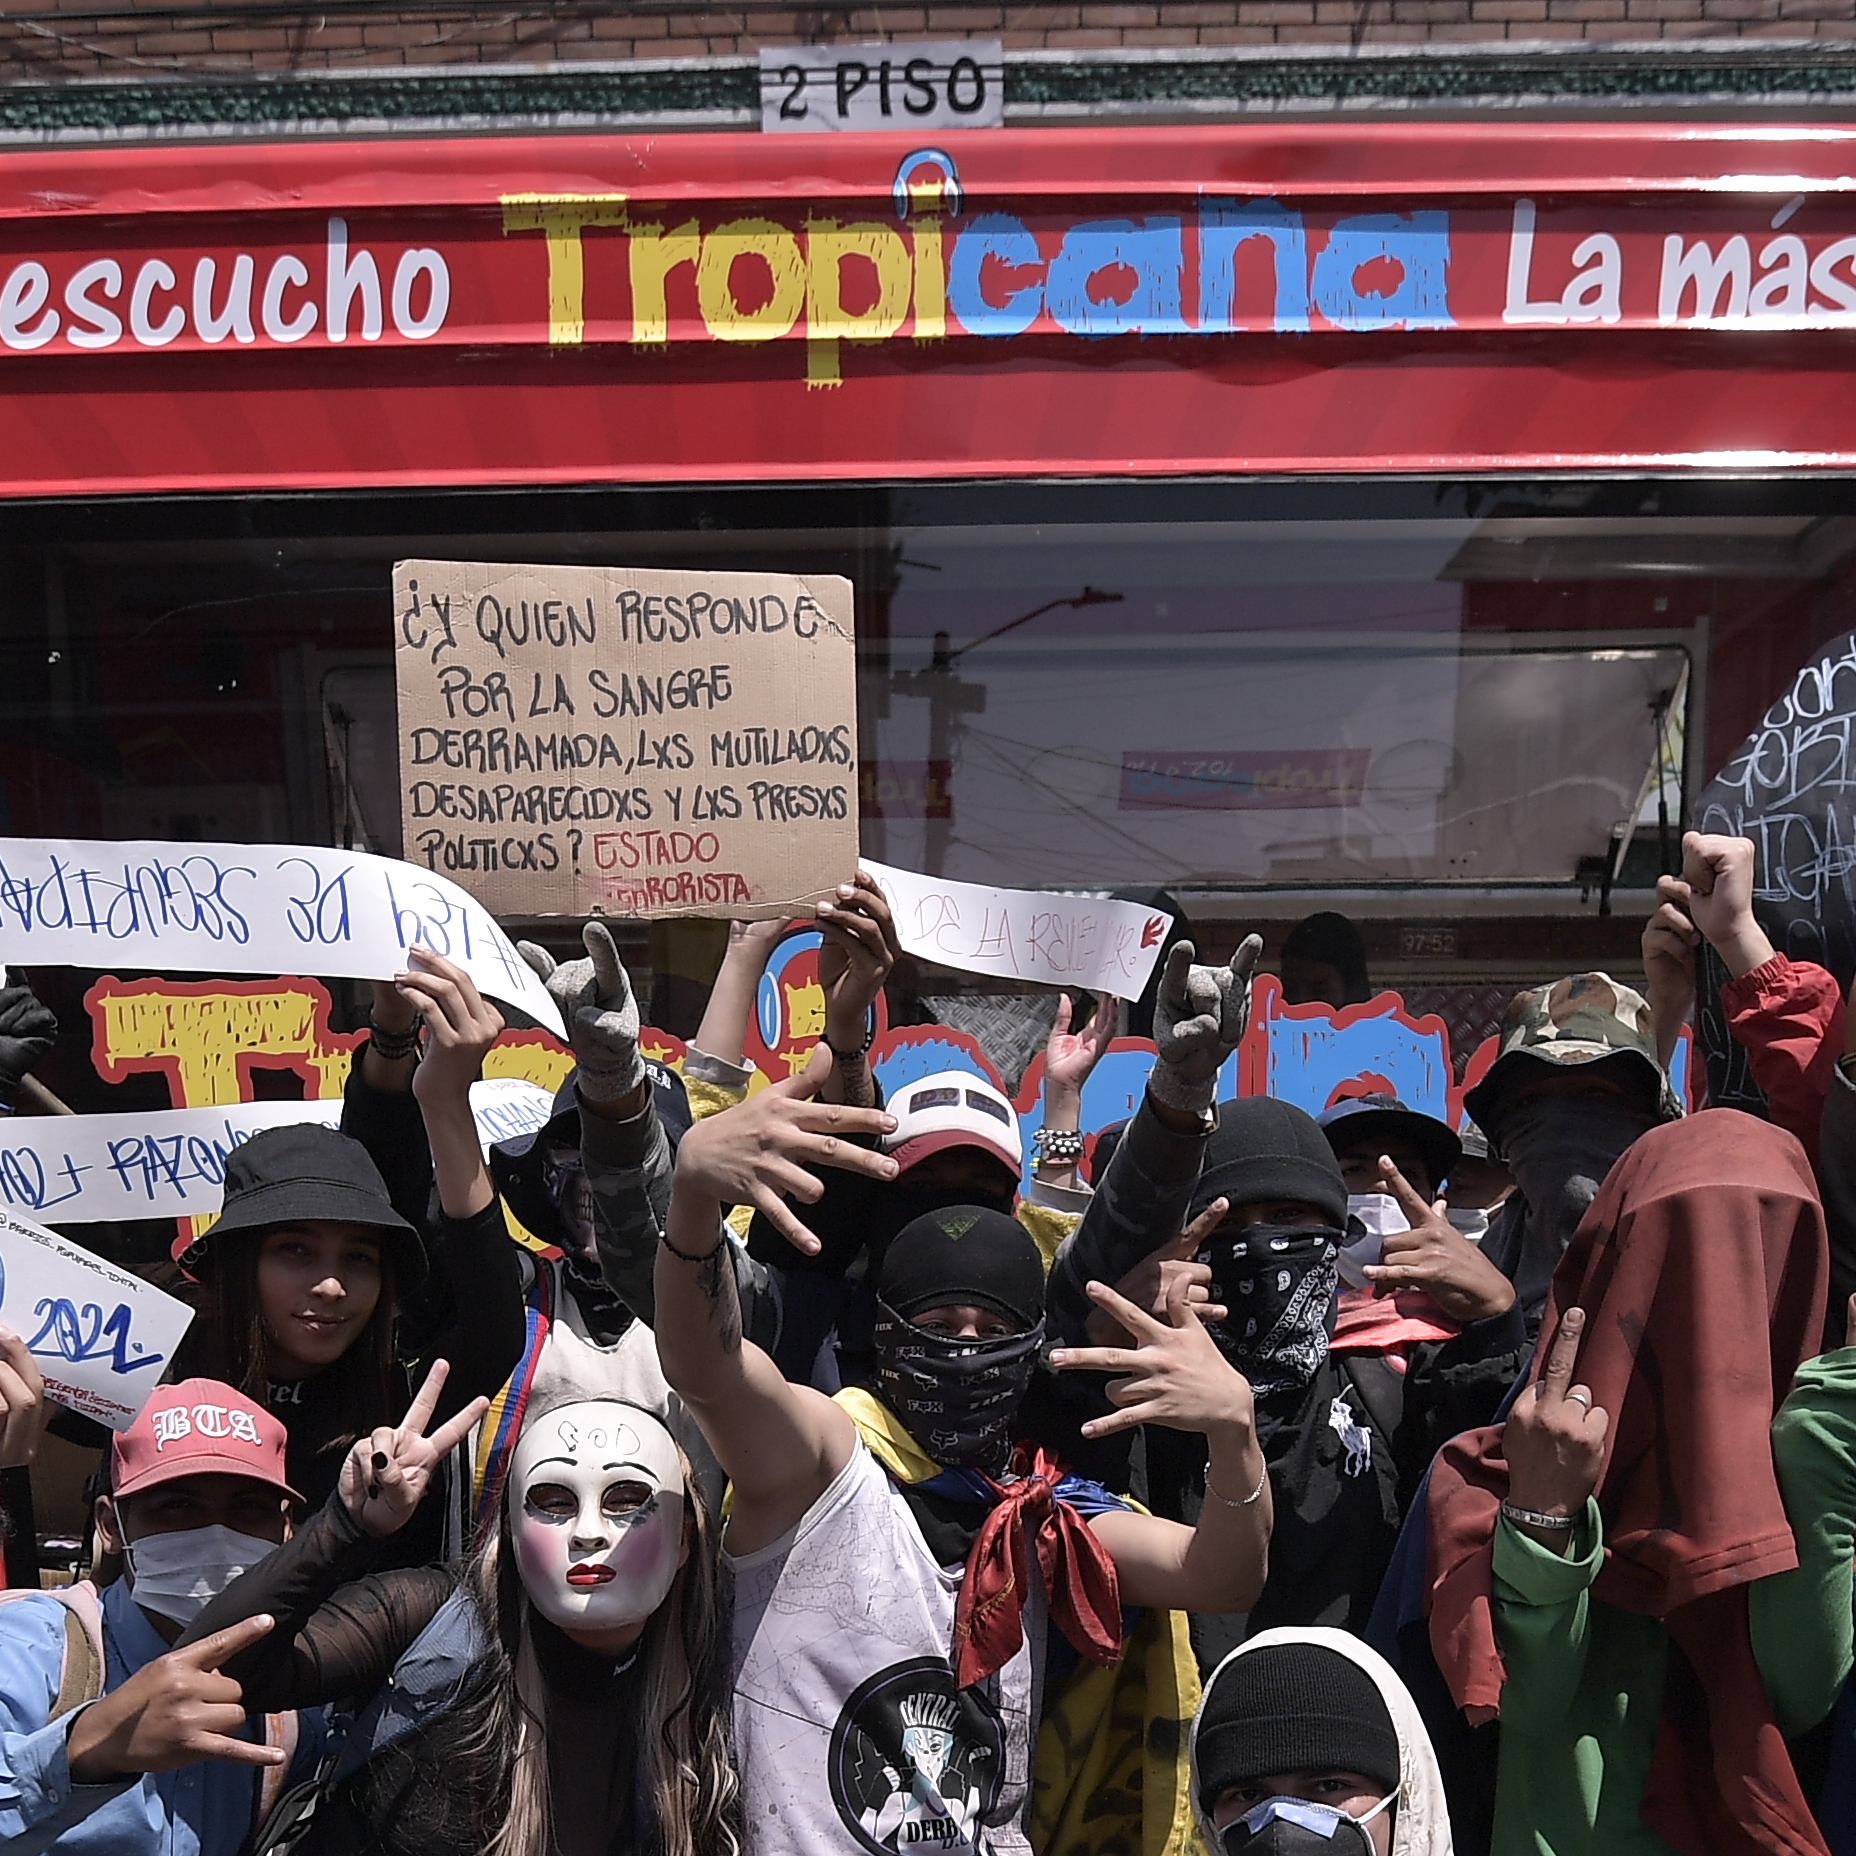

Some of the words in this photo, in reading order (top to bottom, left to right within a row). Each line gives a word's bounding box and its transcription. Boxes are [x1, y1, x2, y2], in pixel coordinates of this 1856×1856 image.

[778, 68, 809, 118] 2
[834, 59, 988, 118] PISO
[499, 182, 1451, 392] Tropicana
[1503, 199, 1624, 326] La
[476, 596, 597, 658] QUIEN
[616, 589, 820, 648] RESPONDE
[437, 664, 515, 722] POR
[529, 668, 576, 718] LA
[588, 664, 734, 718] SANGRE
[410, 780, 654, 824] DESAPARECIDXS
[663, 784, 684, 822] Y
[690, 782, 743, 822] LXS
[750, 780, 850, 823] PRESXS
[592, 831, 721, 870] ESTADO
[912, 893, 964, 956] DE
[968, 906, 1021, 976] LA
[900, 1692, 962, 1731] CENTRAL
